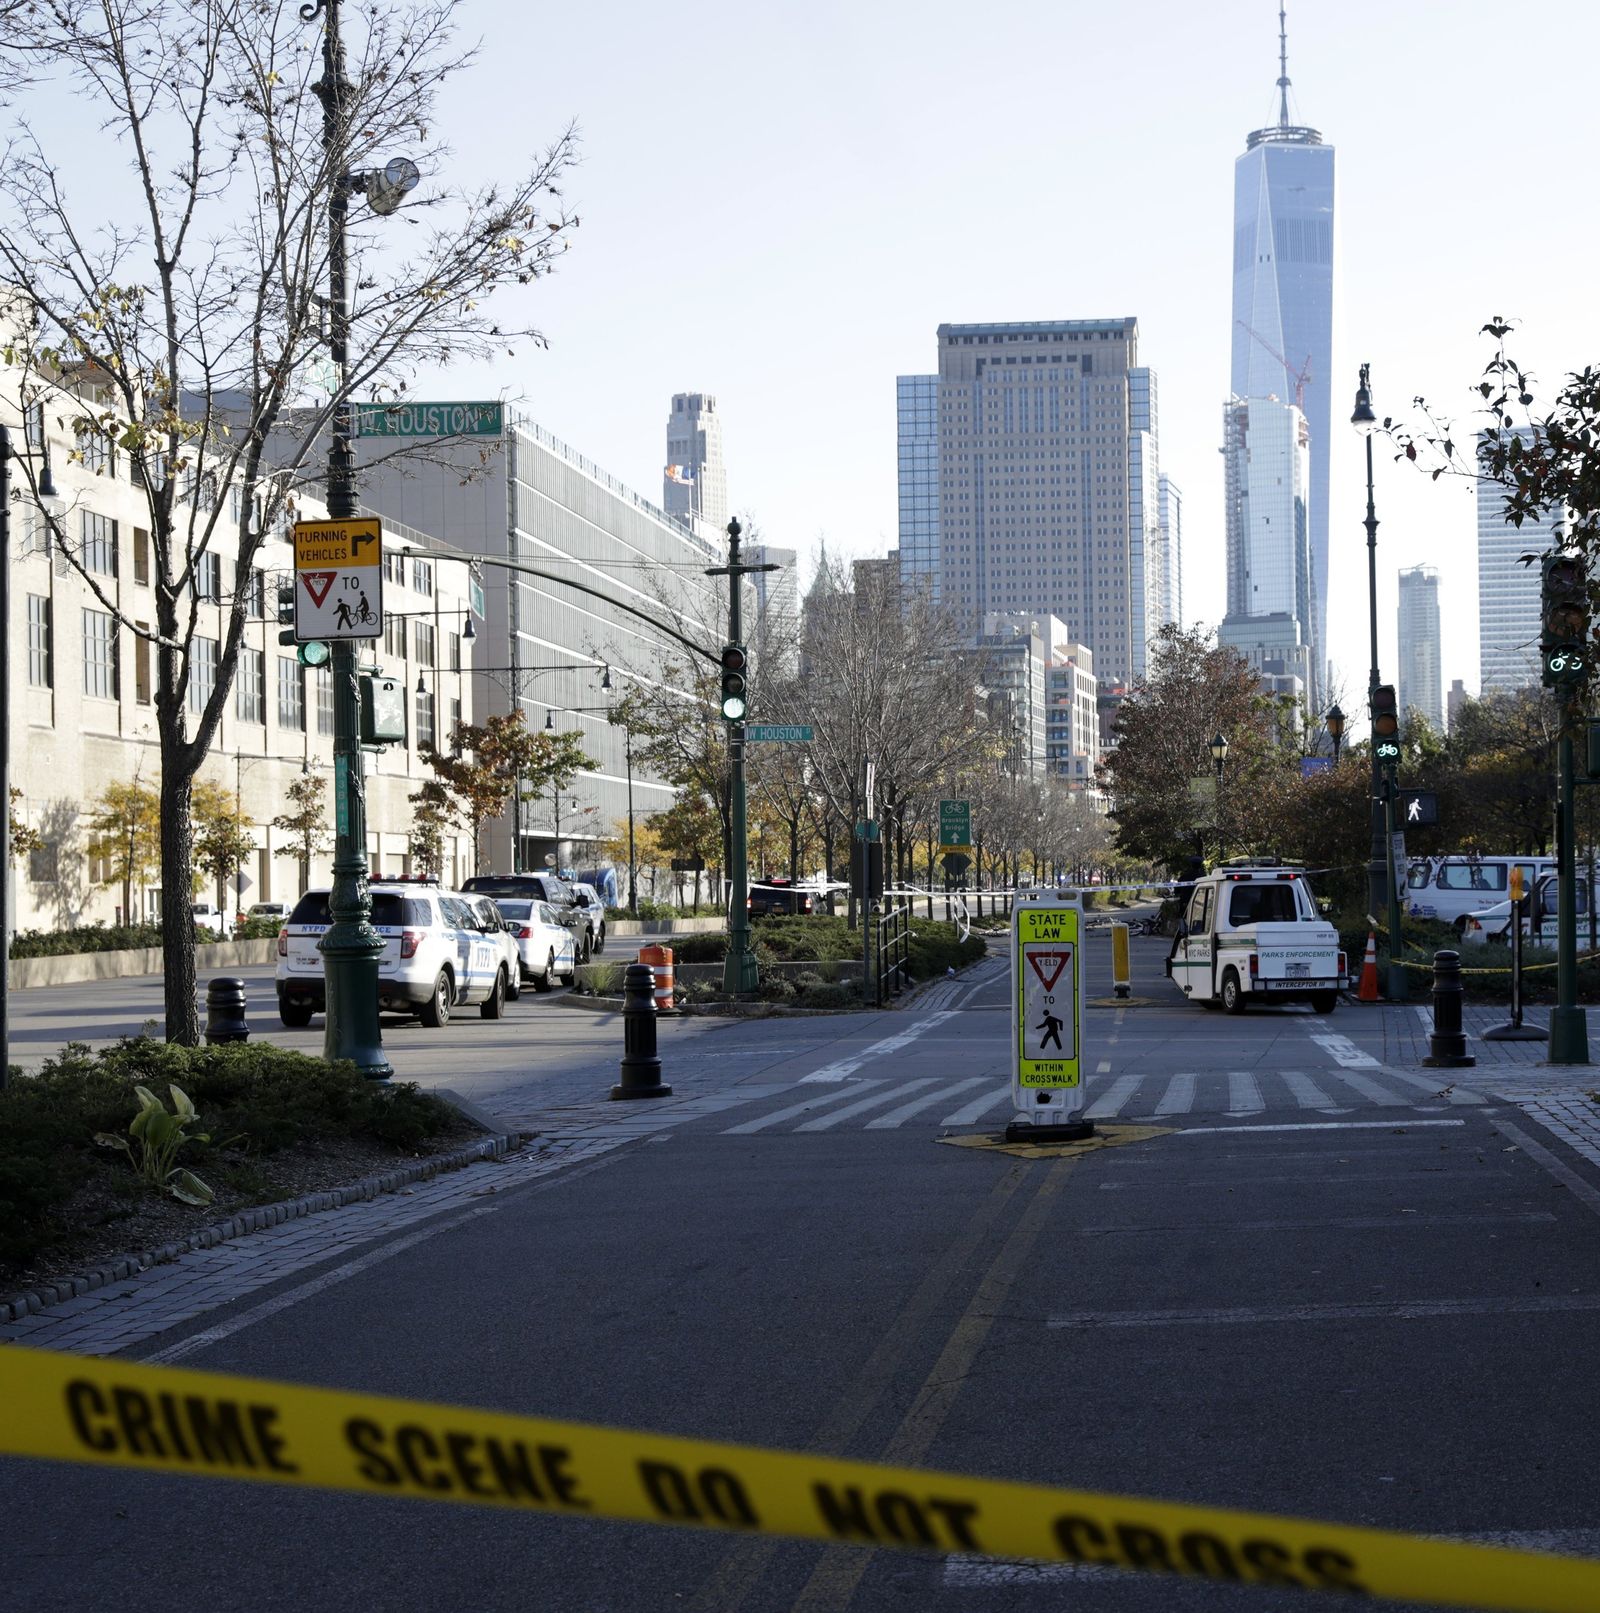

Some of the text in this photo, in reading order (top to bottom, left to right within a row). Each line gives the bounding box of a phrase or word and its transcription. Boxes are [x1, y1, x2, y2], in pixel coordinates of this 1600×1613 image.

[360, 406, 375, 433] W
[386, 406, 479, 433] HOUSTON
[298, 530, 348, 544] TURNING
[299, 549, 347, 562] VEHICLES
[342, 577, 360, 590] TO
[749, 727, 757, 739] W
[760, 727, 803, 740] HOUSTON
[1029, 914, 1066, 925] STATE
[301, 925, 326, 933] NYPD
[1034, 928, 1060, 939] LAW
[1261, 951, 1285, 959] PARKS
[1043, 996, 1055, 1004] TO
[1034, 1064, 1064, 1072] WITHIN
[1025, 1075, 1073, 1083] CROSSWALK
[63, 1377, 1374, 1596] CRIME SCENE DO NOT CROSS
